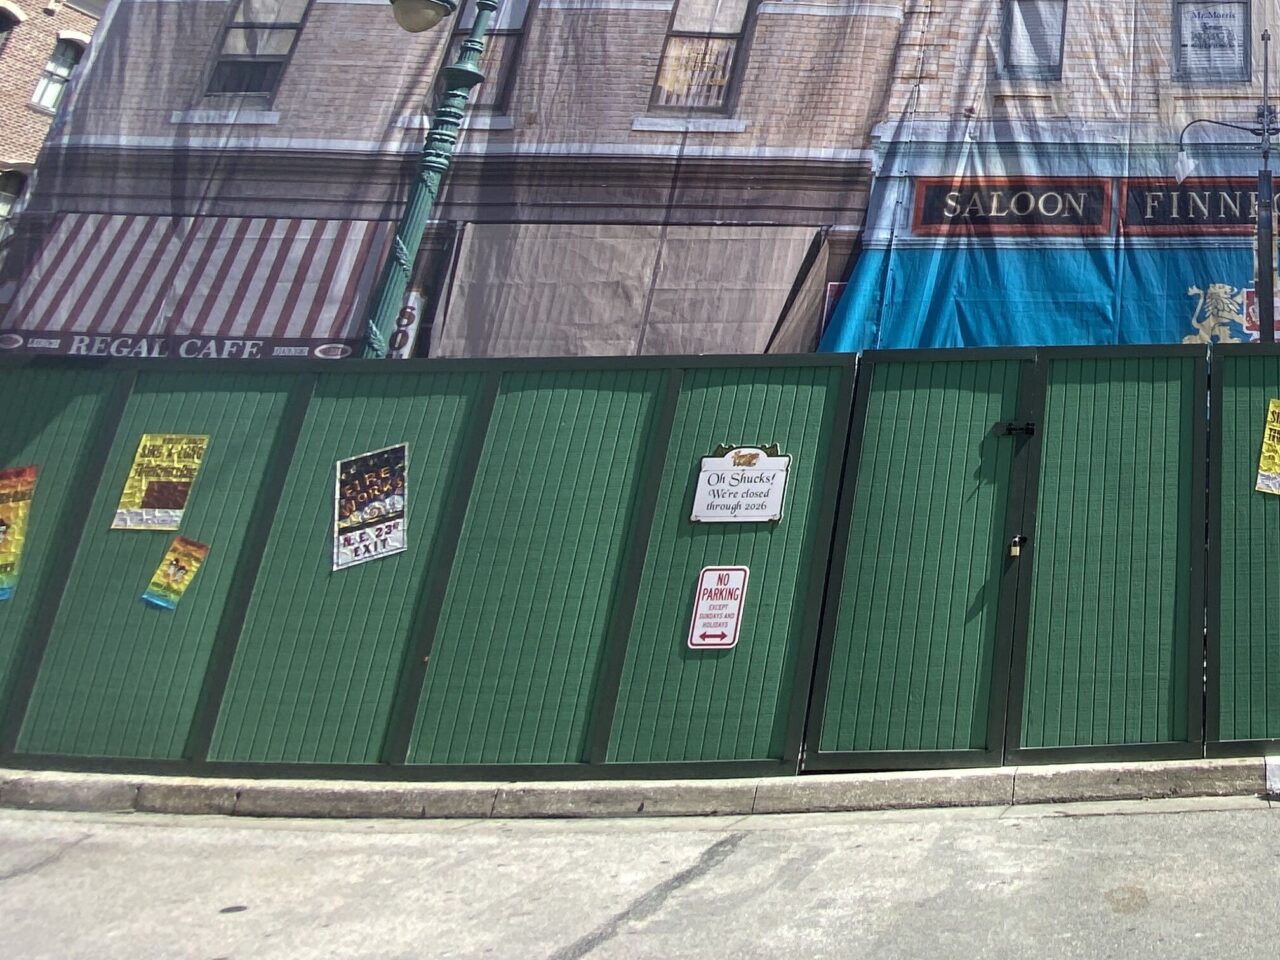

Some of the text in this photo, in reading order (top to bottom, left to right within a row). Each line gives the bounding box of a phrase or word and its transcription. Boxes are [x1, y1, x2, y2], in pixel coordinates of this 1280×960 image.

[943, 191, 1087, 217] SALOON
[68, 335, 168, 357] REGAL
[179, 338, 265, 359] CAFE
[343, 465, 392, 497] FIRE
[707, 472, 776, 488] Oh Shucks!
[340, 478, 403, 517] WORKS
[708, 488, 771, 499] We're closed
[706, 501, 767, 515] through 2026
[353, 538, 388, 557] EXIT
[716, 573, 730, 586] NO
[702, 587, 740, 601] PARKING
[698, 612, 724, 620] SUNDAYS
